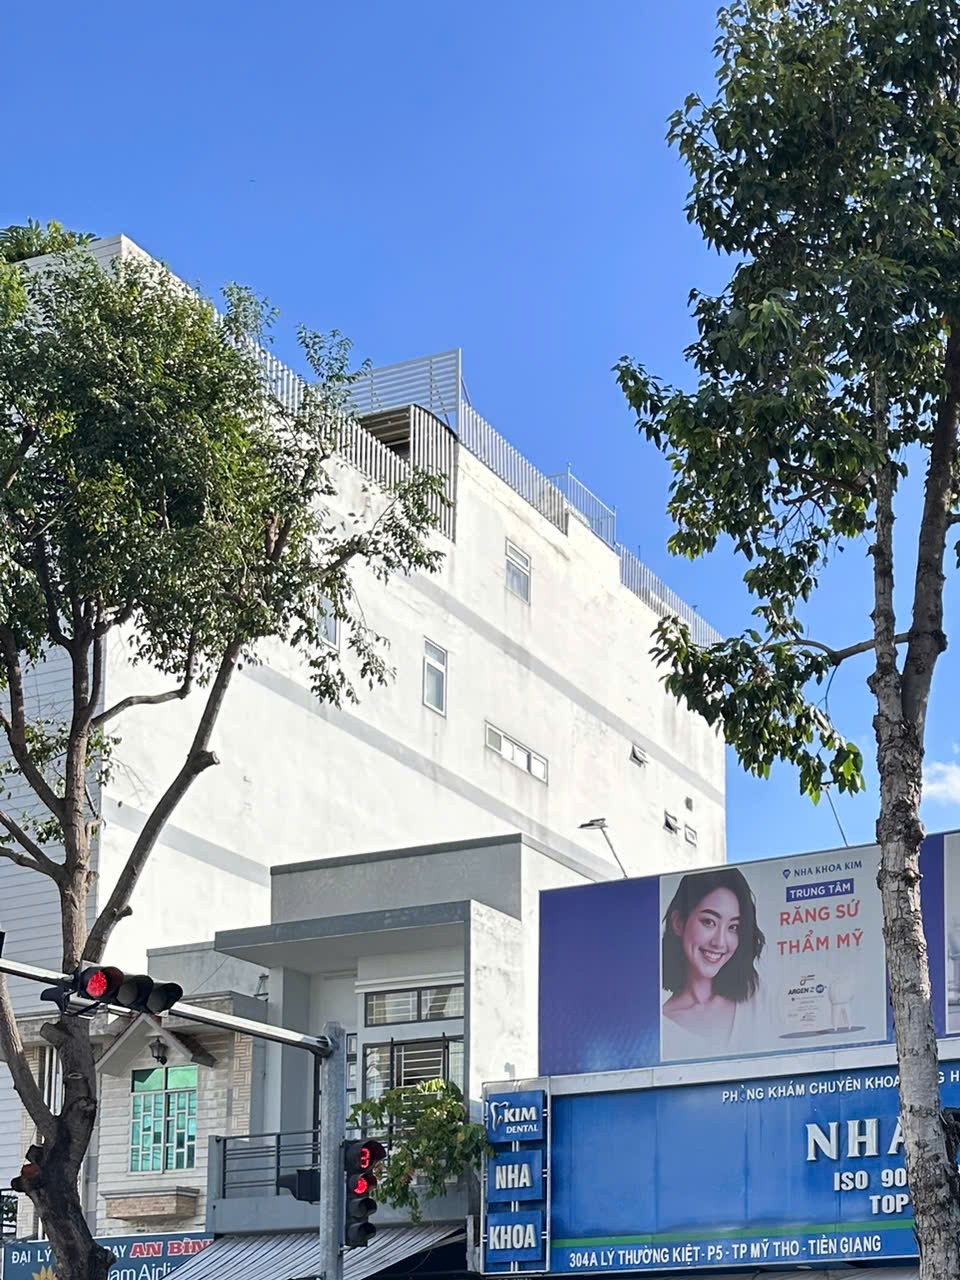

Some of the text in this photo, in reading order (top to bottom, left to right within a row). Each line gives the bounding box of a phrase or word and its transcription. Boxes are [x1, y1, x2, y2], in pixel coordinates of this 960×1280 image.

[794, 860, 862, 877] NHA KHOA KIM
[790, 880, 851, 899] TRUNG TÂM
[780, 900, 860, 926] RĂNG SỨ
[777, 929, 864, 955] THẨM MỸ
[722, 1075, 900, 1102] PHNG KHÁM CHUYÊN KHOA
[504, 1106, 537, 1123] KIM
[506, 1124, 539, 1135] DENTAL
[360, 1148, 370, 1169] 3
[495, 1163, 532, 1190] NHA
[834, 1171, 869, 1192] ISO
[869, 1194, 909, 1215] TOP
[489, 1224, 537, 1250] KHOA
[11, 1237, 214, 1266] ĐẠI LÝ AY AN BÌN
[569, 1251, 598, 1268] 304A
[600, 1247, 615, 1267] LÝ
[618, 1245, 669, 1266] THƯỜNG
[672, 1243, 701, 1265] KIỆT
[708, 1245, 723, 1262] P5
[732, 1243, 748, 1260] TP
[751, 1238, 769, 1259] MỸ
[773, 1240, 800, 1257] THO
[808, 1234, 837, 1255] TIỀN
[840, 1235, 881, 1253] GIANG
